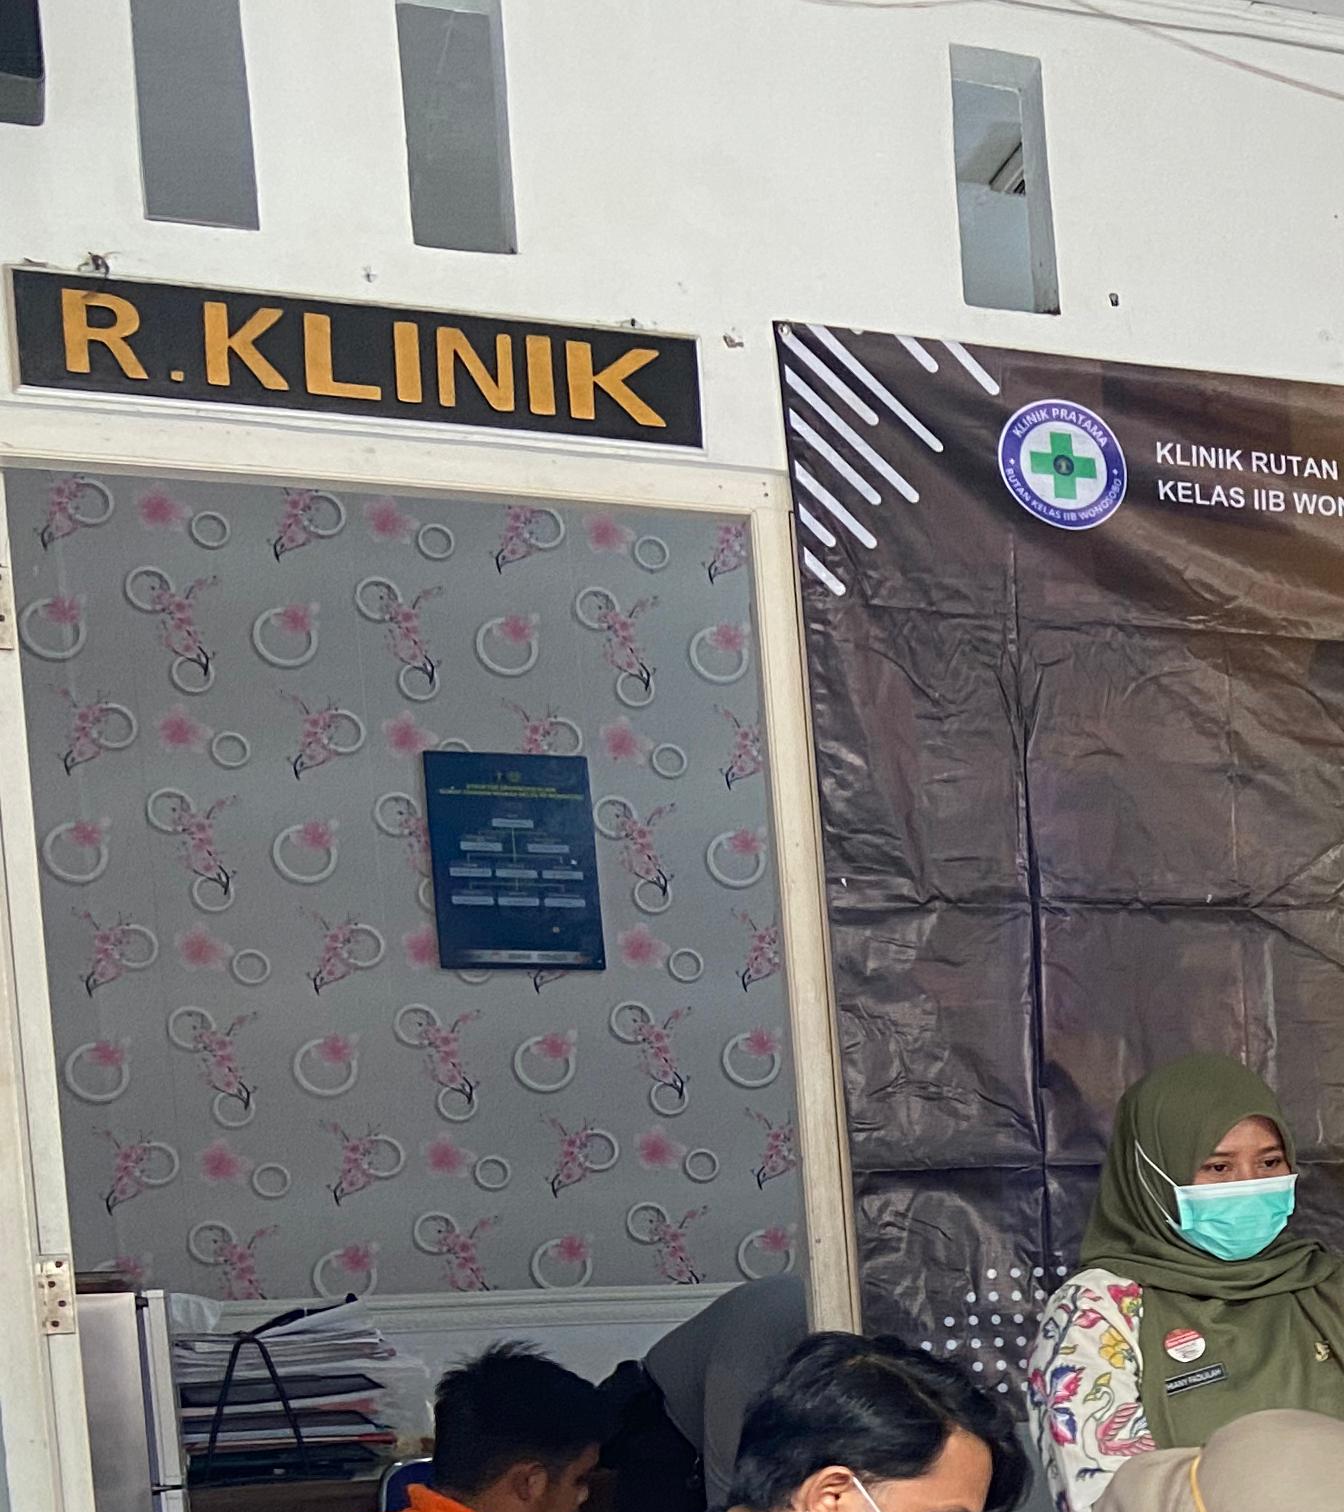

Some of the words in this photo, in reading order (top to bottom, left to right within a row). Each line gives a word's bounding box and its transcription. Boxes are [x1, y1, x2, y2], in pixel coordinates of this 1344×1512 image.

[1012, 408, 1050, 439] KLINIK
[1051, 407, 1108, 448] PRATAMA
[1156, 441, 1244, 471] KLINIK
[1251, 451, 1339, 481] RUTAN
[1005, 468, 1032, 502] RUTAN
[1030, 499, 1061, 519] KELAS
[1079, 478, 1122, 520] WONOSOBO
[1157, 479, 1245, 509] KELAS
[1253, 489, 1286, 512] IIB
